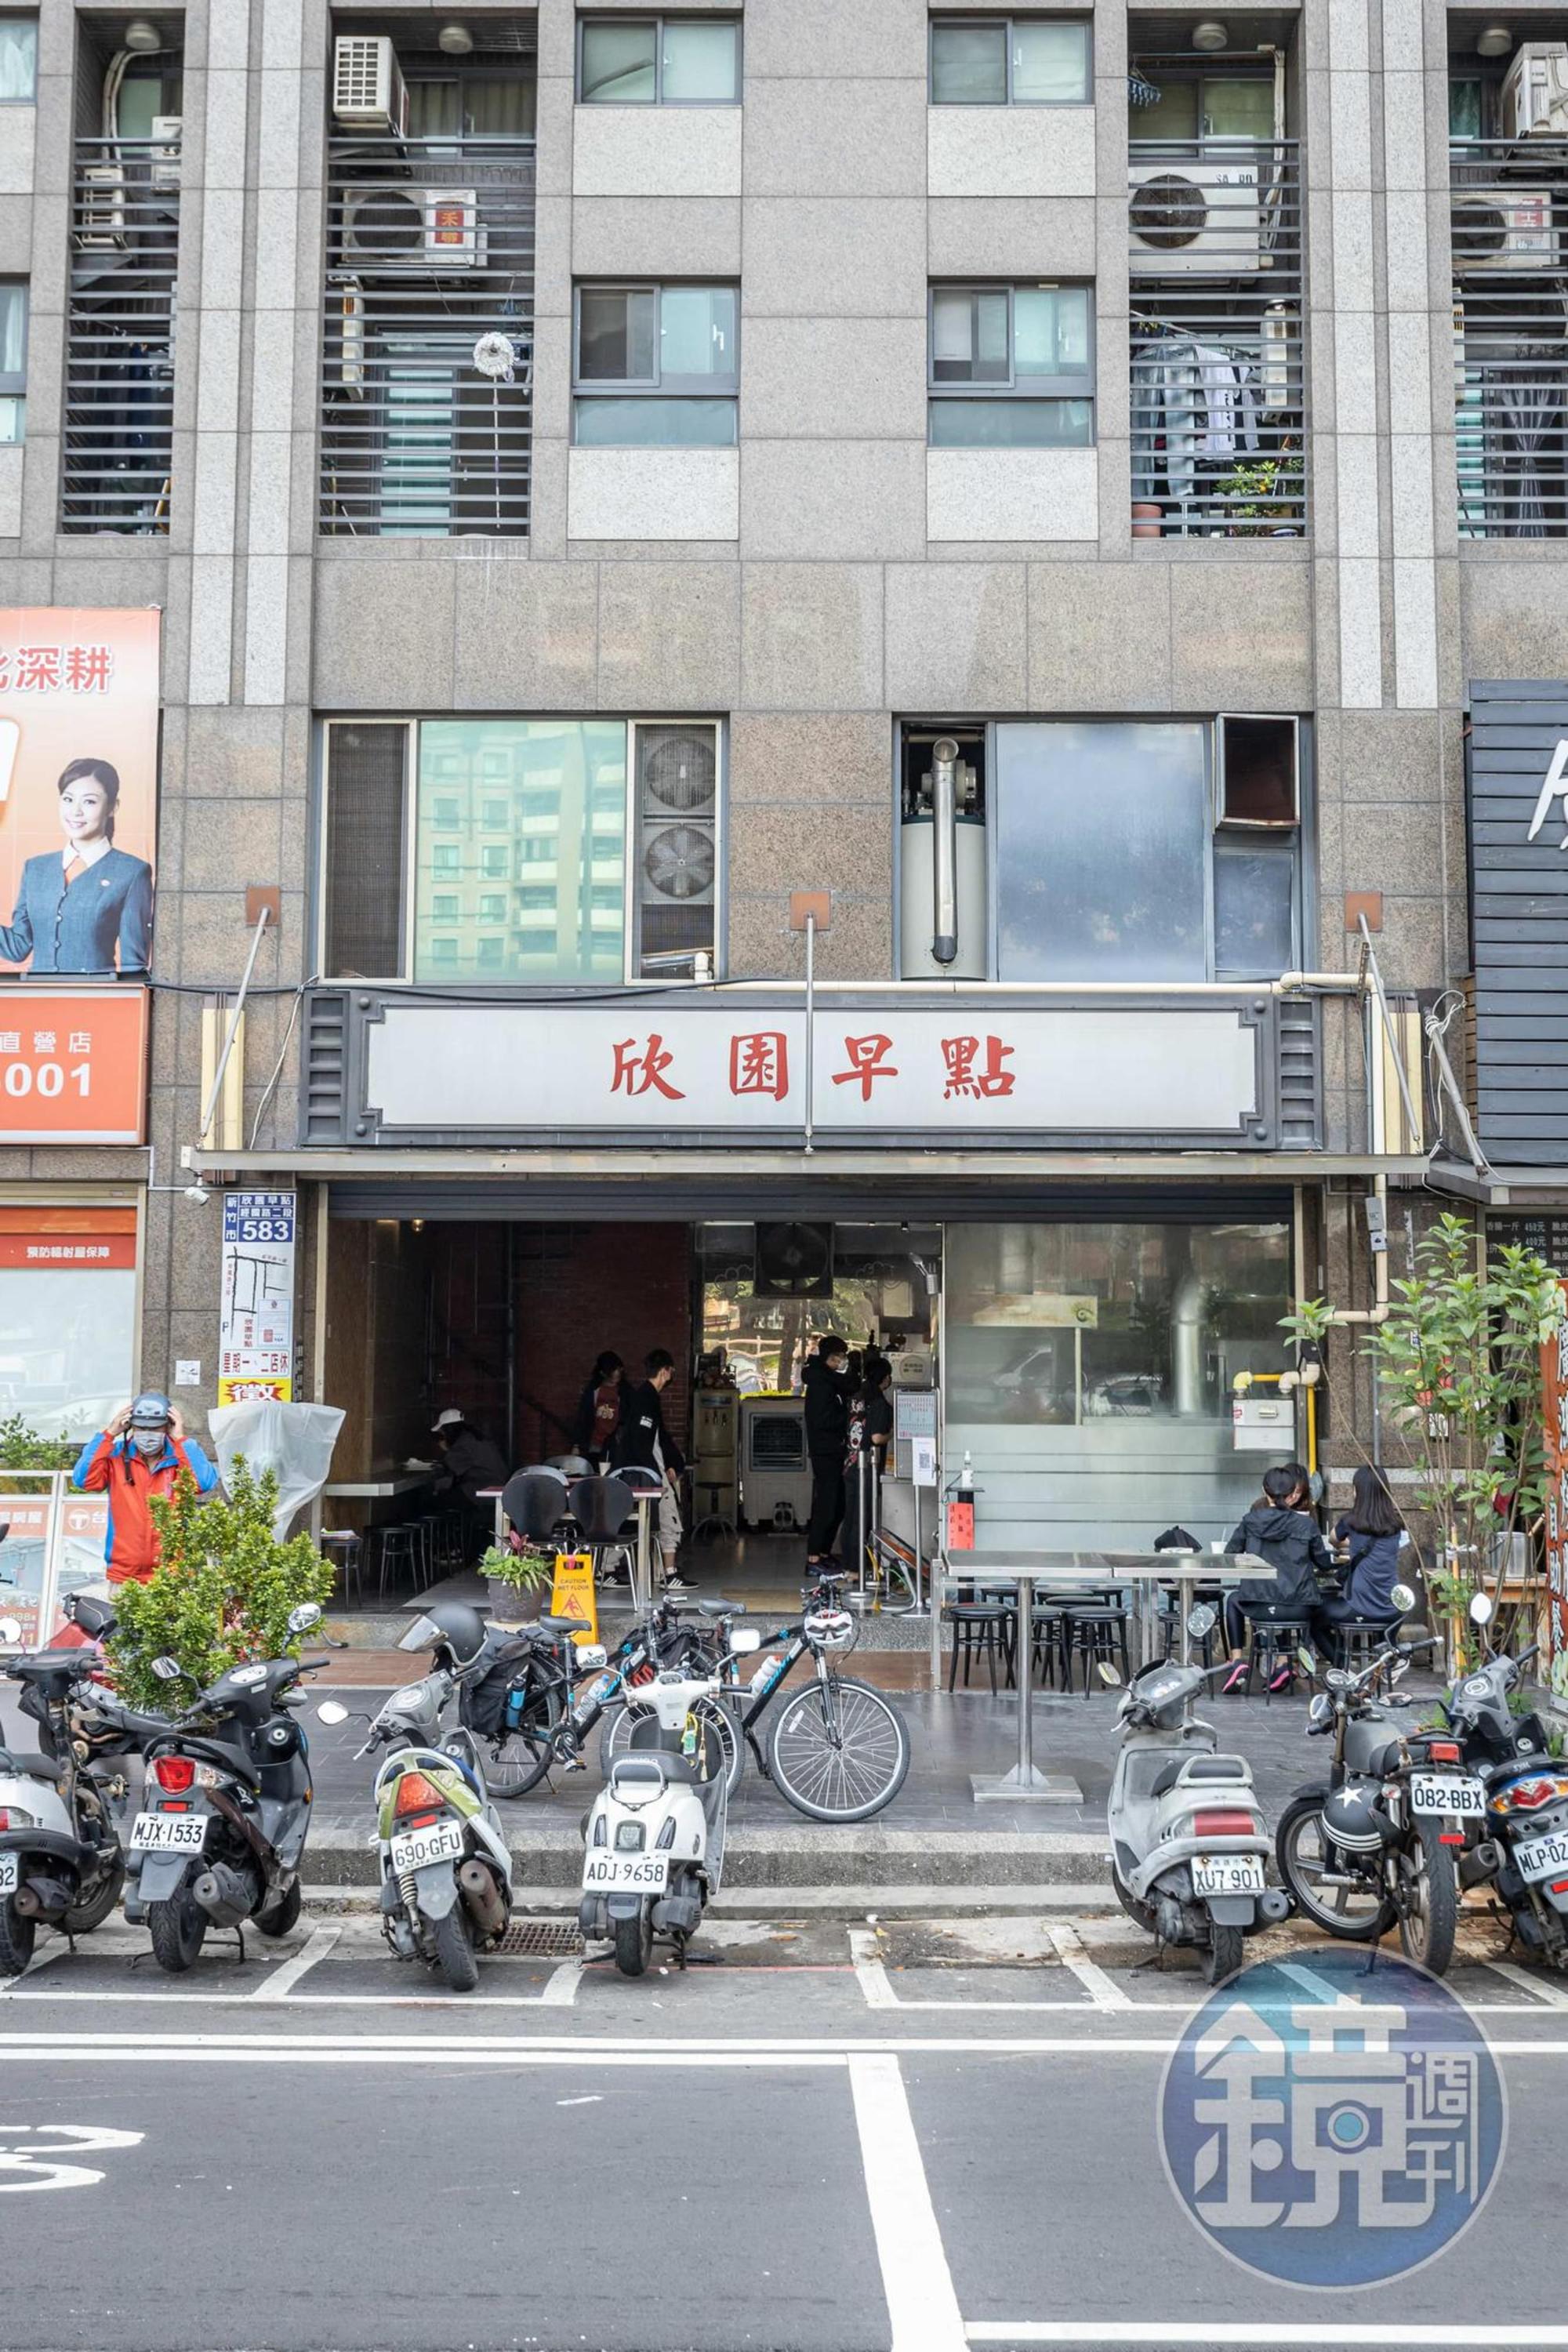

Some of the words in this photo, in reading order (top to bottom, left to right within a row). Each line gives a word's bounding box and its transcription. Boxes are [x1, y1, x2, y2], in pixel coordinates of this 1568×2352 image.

[0, 1031, 91, 1054] 直營店
[5, 1062, 91, 1097] 001
[611, 1033, 1016, 1102] 欣園早點
[241, 1196, 292, 1205] 欣園早點
[226, 1196, 237, 1240] 新竹市
[242, 1221, 289, 1241] 583
